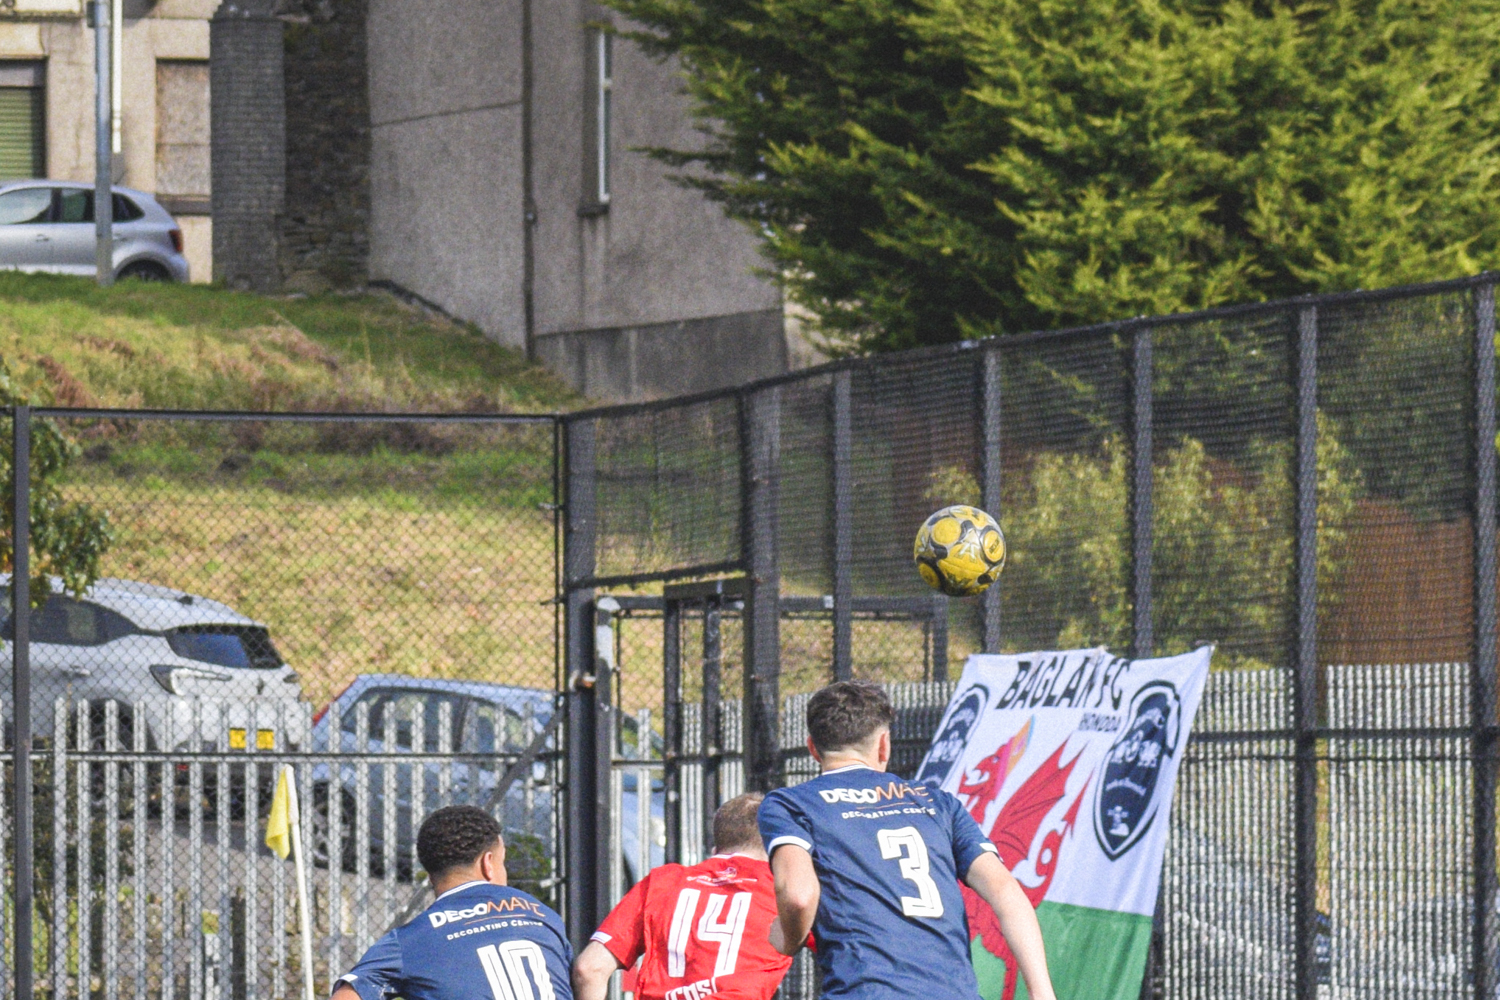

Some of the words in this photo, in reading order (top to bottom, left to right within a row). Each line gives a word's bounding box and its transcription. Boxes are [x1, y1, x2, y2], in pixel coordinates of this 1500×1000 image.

[995, 655, 1105, 710] BAGLAN
[1094, 657, 1131, 711] FC
[877, 826, 944, 918] 3
[446, 920, 509, 941] DECORATING
[667, 888, 753, 978] 14
